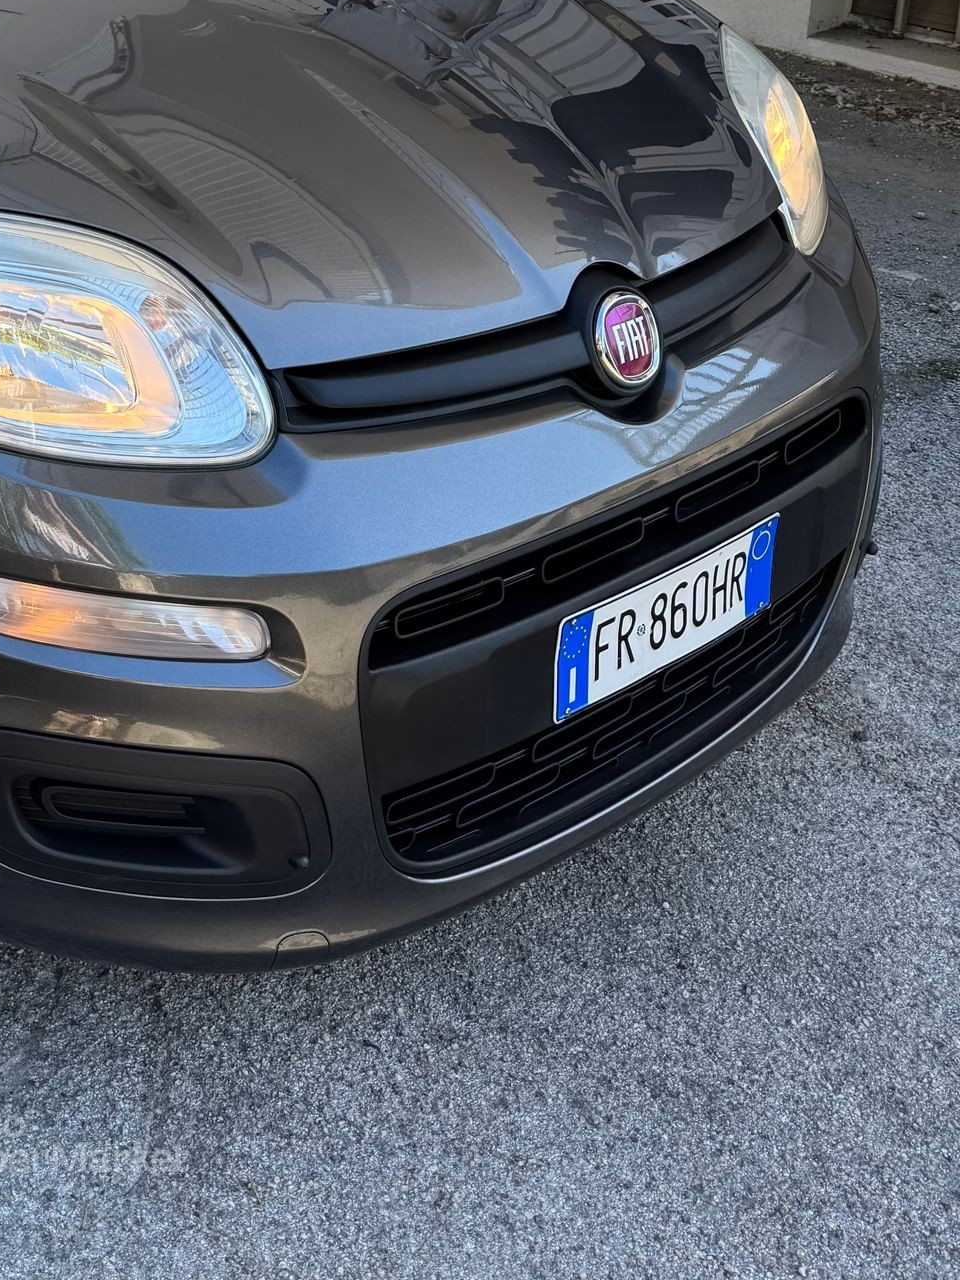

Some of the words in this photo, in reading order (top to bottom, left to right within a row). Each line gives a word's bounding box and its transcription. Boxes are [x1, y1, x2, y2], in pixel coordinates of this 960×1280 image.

[611, 315, 650, 365] FIAT
[593, 608, 637, 682] FR
[648, 551, 747, 651] 860HR
